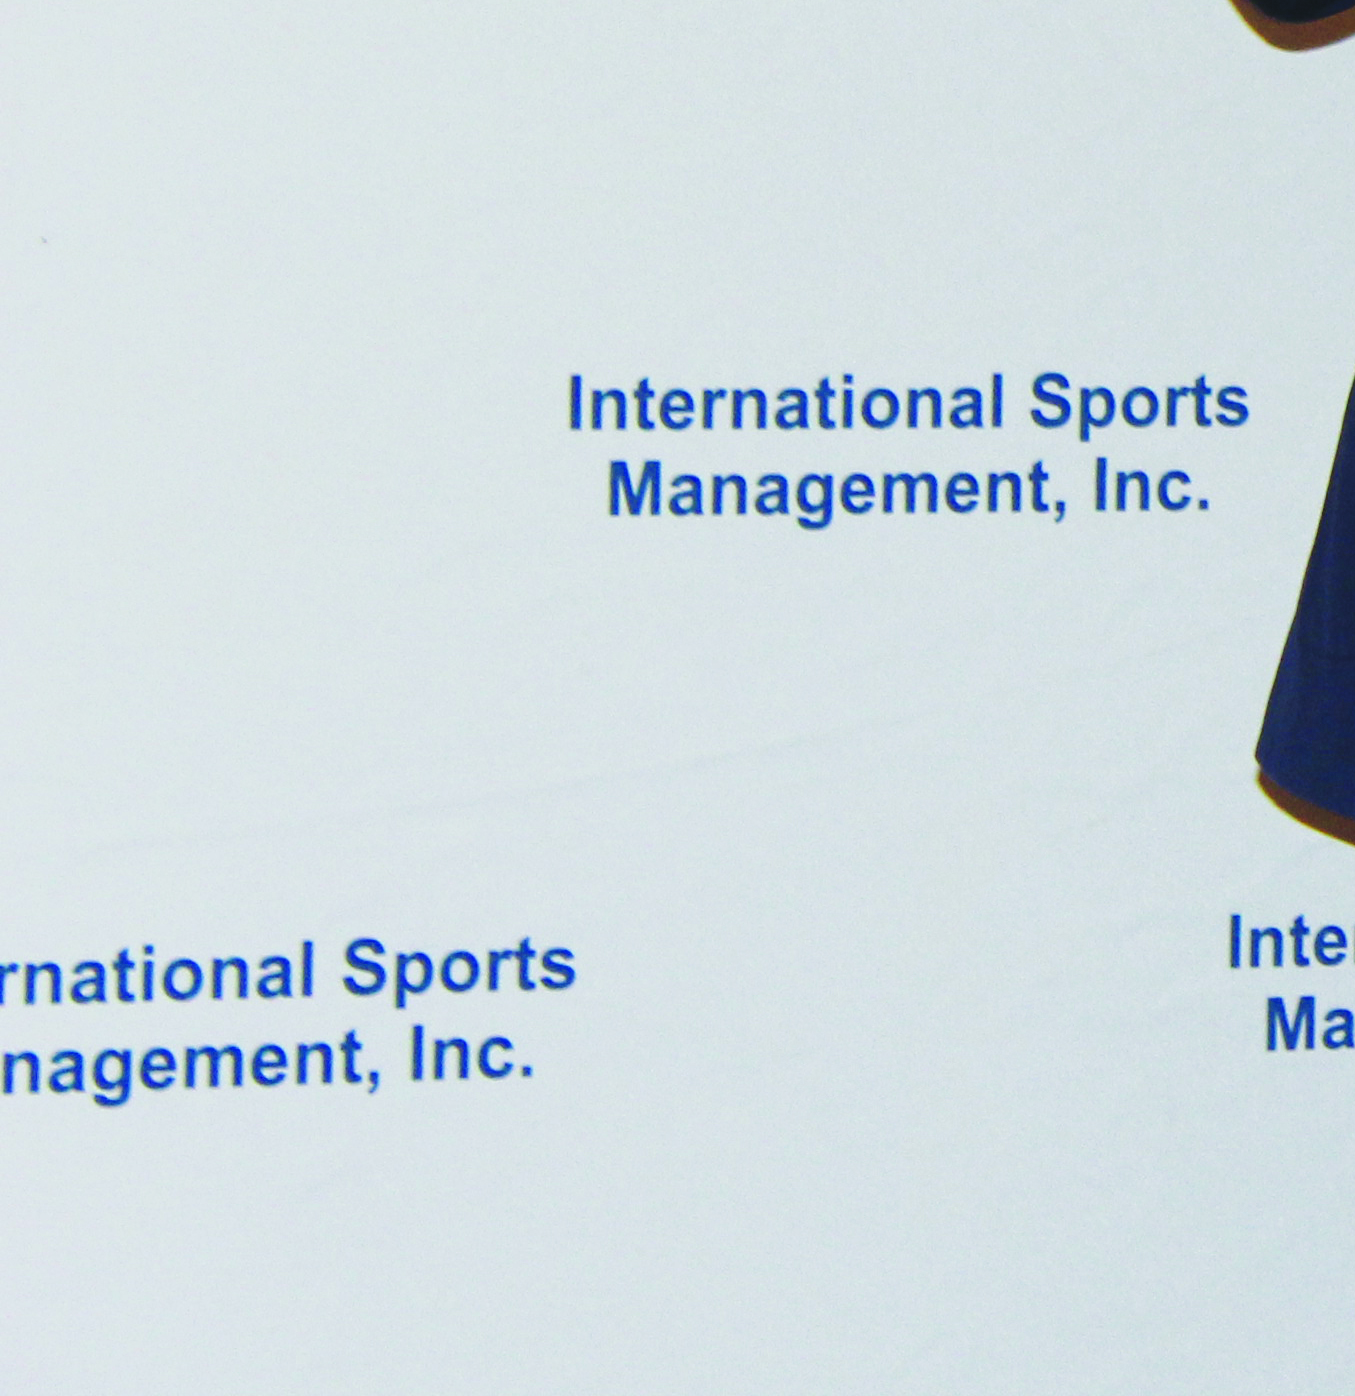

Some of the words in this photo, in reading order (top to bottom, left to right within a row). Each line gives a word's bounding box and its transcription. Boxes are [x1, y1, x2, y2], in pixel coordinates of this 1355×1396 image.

[570, 372, 1004, 432] International
[1030, 371, 1250, 443] Sports
[609, 459, 1067, 531] Management,
[1095, 456, 1210, 512] Inc.
[0, 939, 315, 1006] rnational
[342, 936, 577, 1010] Sports
[2, 1028, 381, 1108] nagement,
[411, 1023, 534, 1082] Inc.
